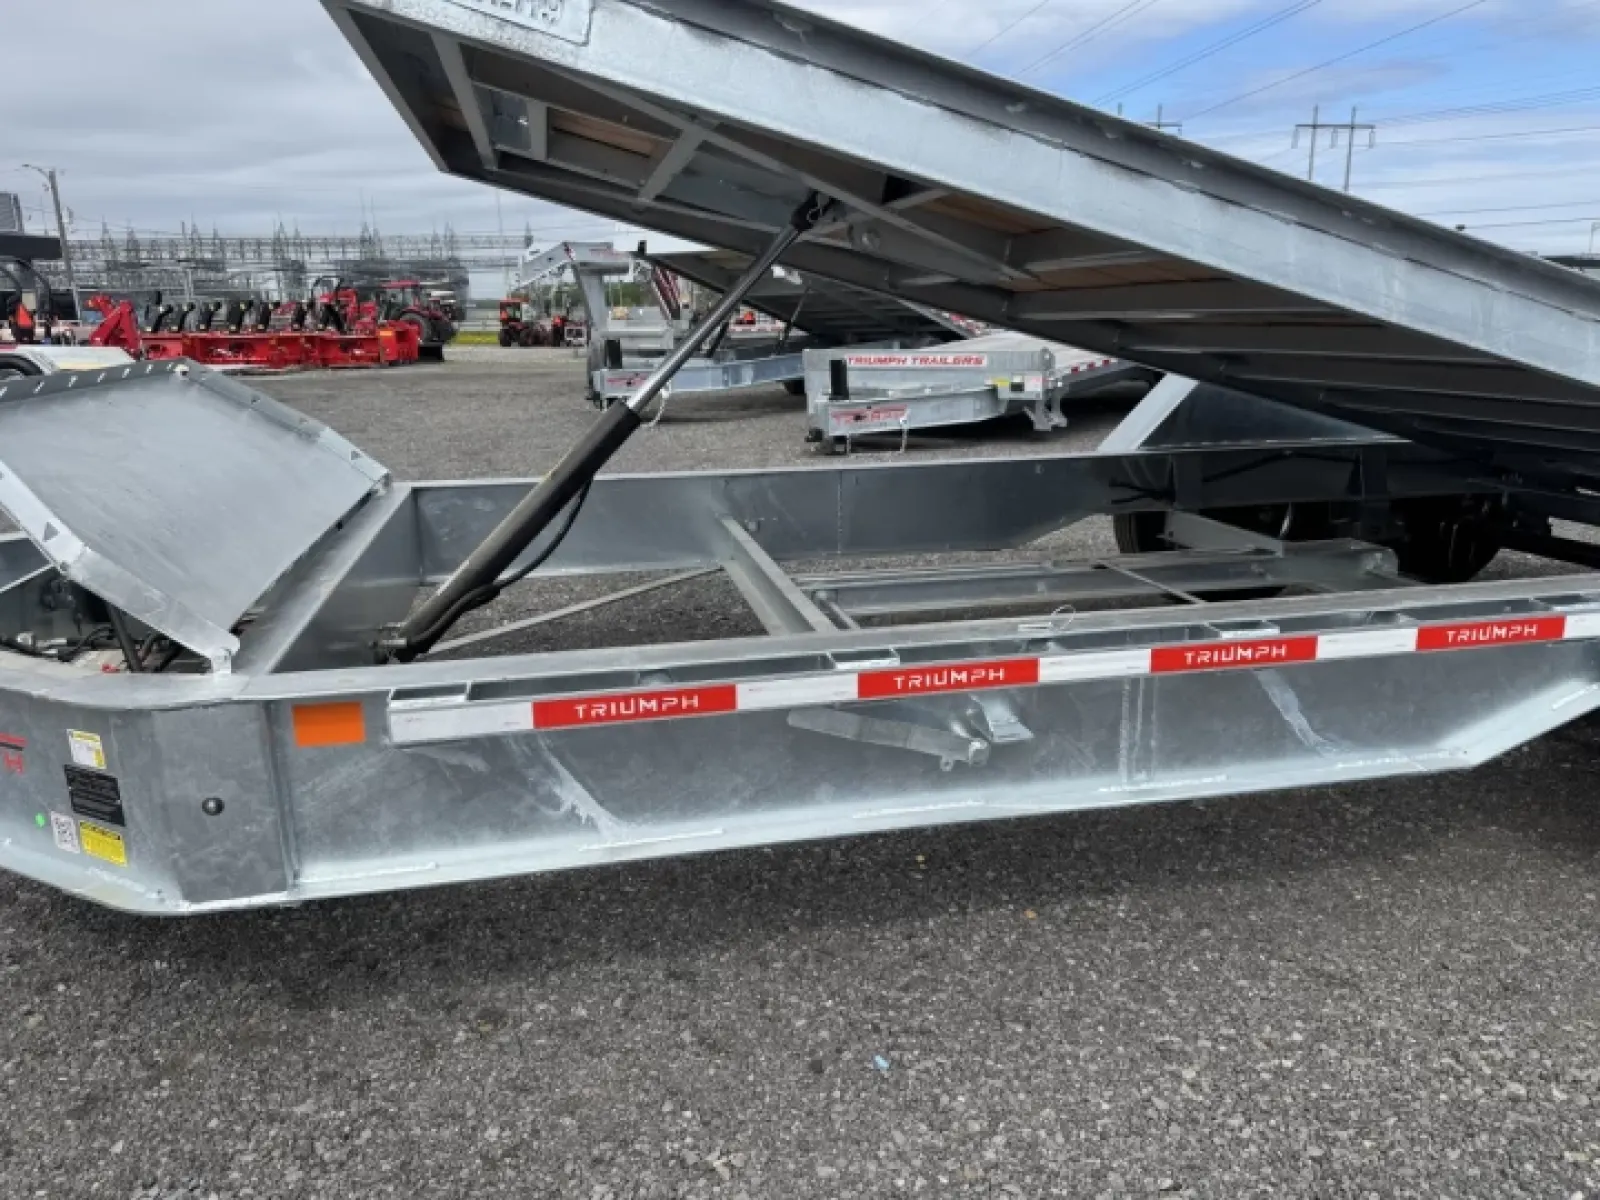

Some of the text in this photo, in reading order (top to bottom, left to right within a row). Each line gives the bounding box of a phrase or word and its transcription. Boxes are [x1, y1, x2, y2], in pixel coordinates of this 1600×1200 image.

[1446, 623, 1538, 643] TRIUMPH
[1184, 643, 1287, 665] TRIUMPH
[893, 667, 1005, 689] TRIUMPH
[573, 694, 699, 719] TRIUMPH
